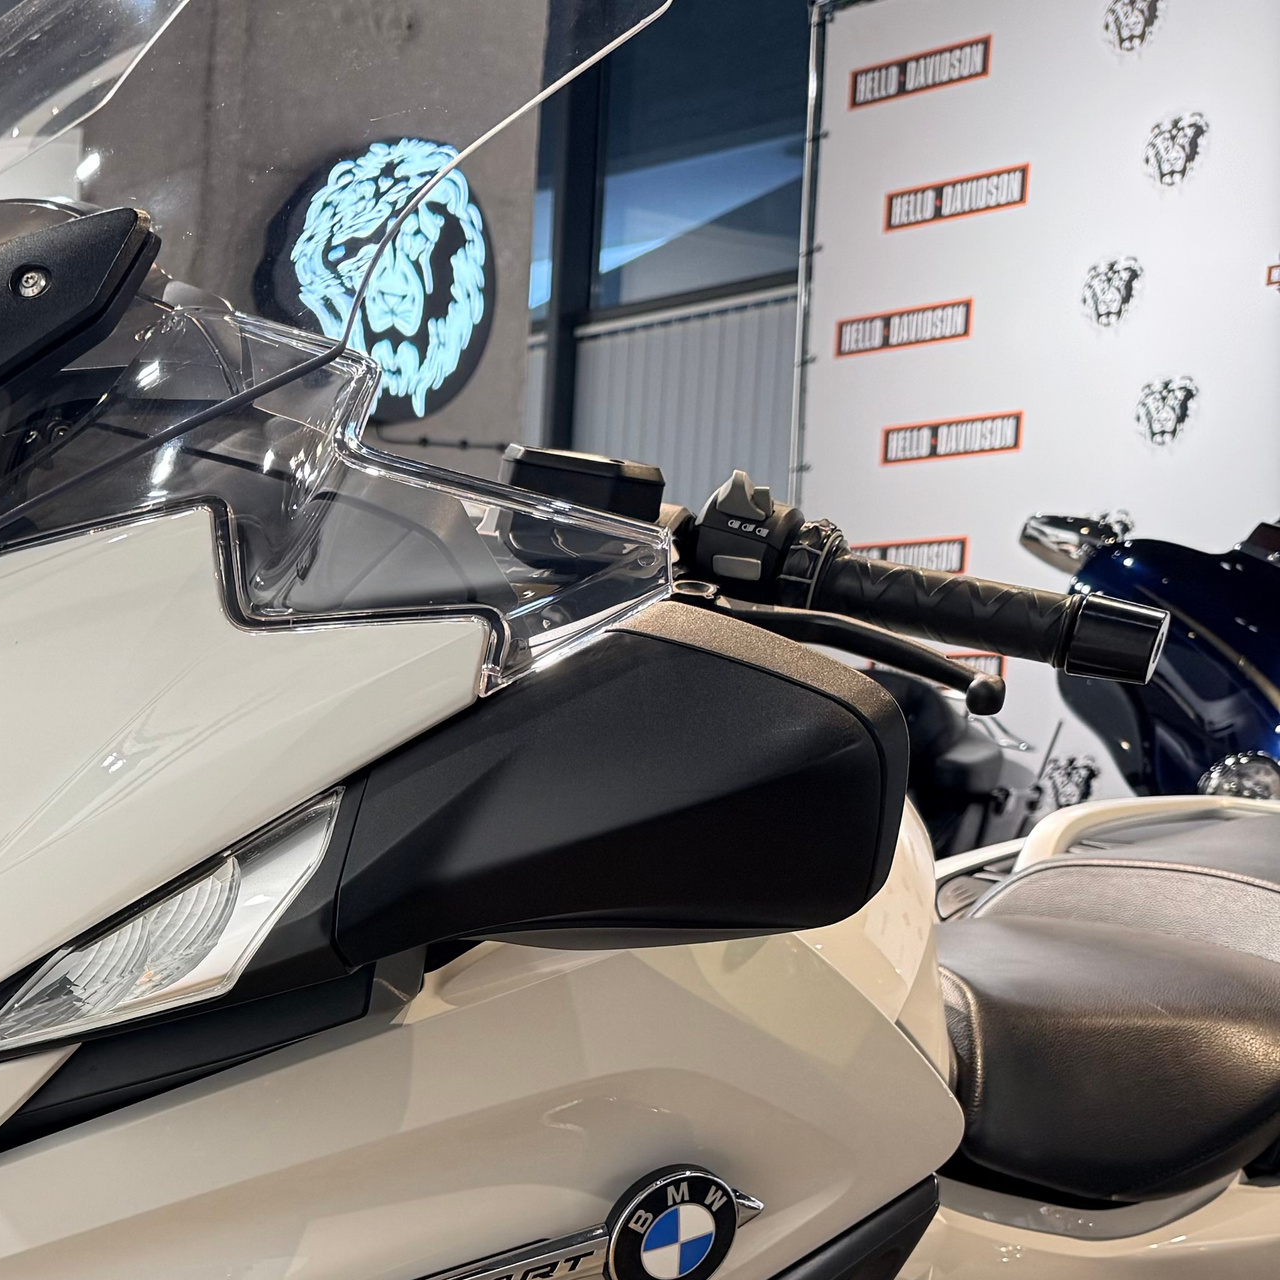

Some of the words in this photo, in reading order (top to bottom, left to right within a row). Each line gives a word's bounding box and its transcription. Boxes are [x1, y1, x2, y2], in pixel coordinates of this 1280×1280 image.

[855, 65, 900, 104] HELLO
[905, 42, 985, 92] DAVIDSON
[891, 189, 936, 226] HELLO
[941, 170, 1023, 216] DAVIDSON
[840, 317, 884, 354] HELLO
[889, 302, 968, 346] DAVIDSON
[887, 426, 932, 461] HELLO
[936, 415, 1017, 455] DAVIDSON
[627, 1180, 728, 1235] BMW
